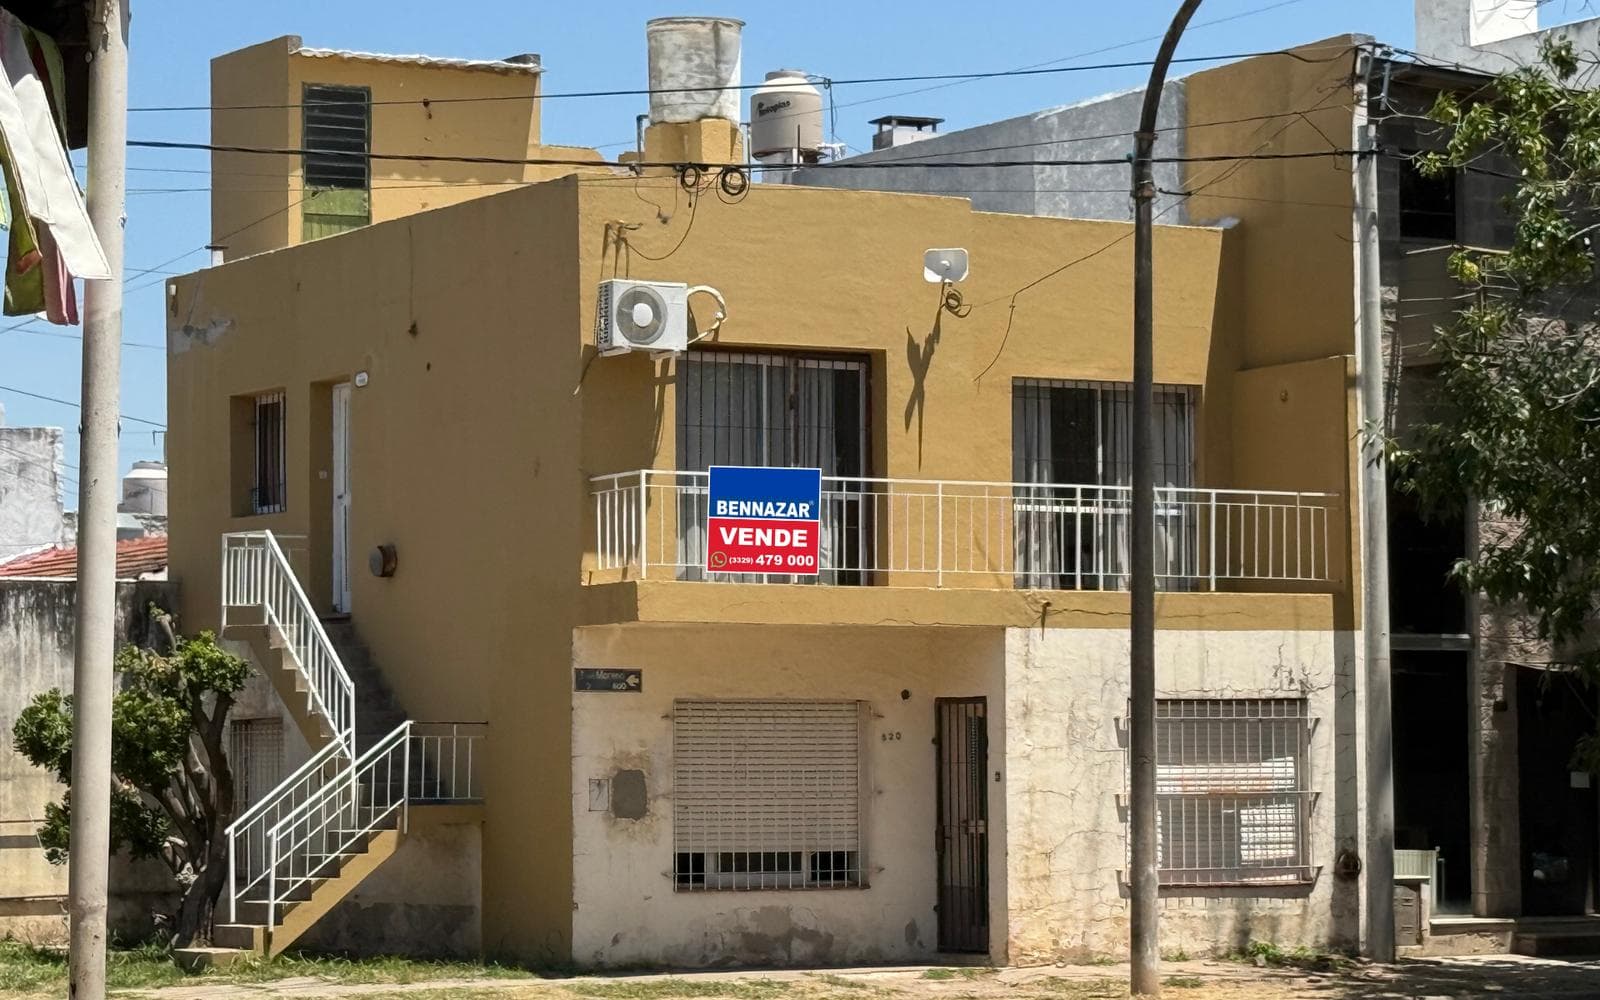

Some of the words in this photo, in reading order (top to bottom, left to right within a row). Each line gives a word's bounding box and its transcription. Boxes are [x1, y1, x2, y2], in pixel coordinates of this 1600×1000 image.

[716, 500, 810, 518] BENNAZAR
[719, 527, 808, 548] VENDE
[755, 555, 783, 566] 479
[787, 555, 814, 566] 000
